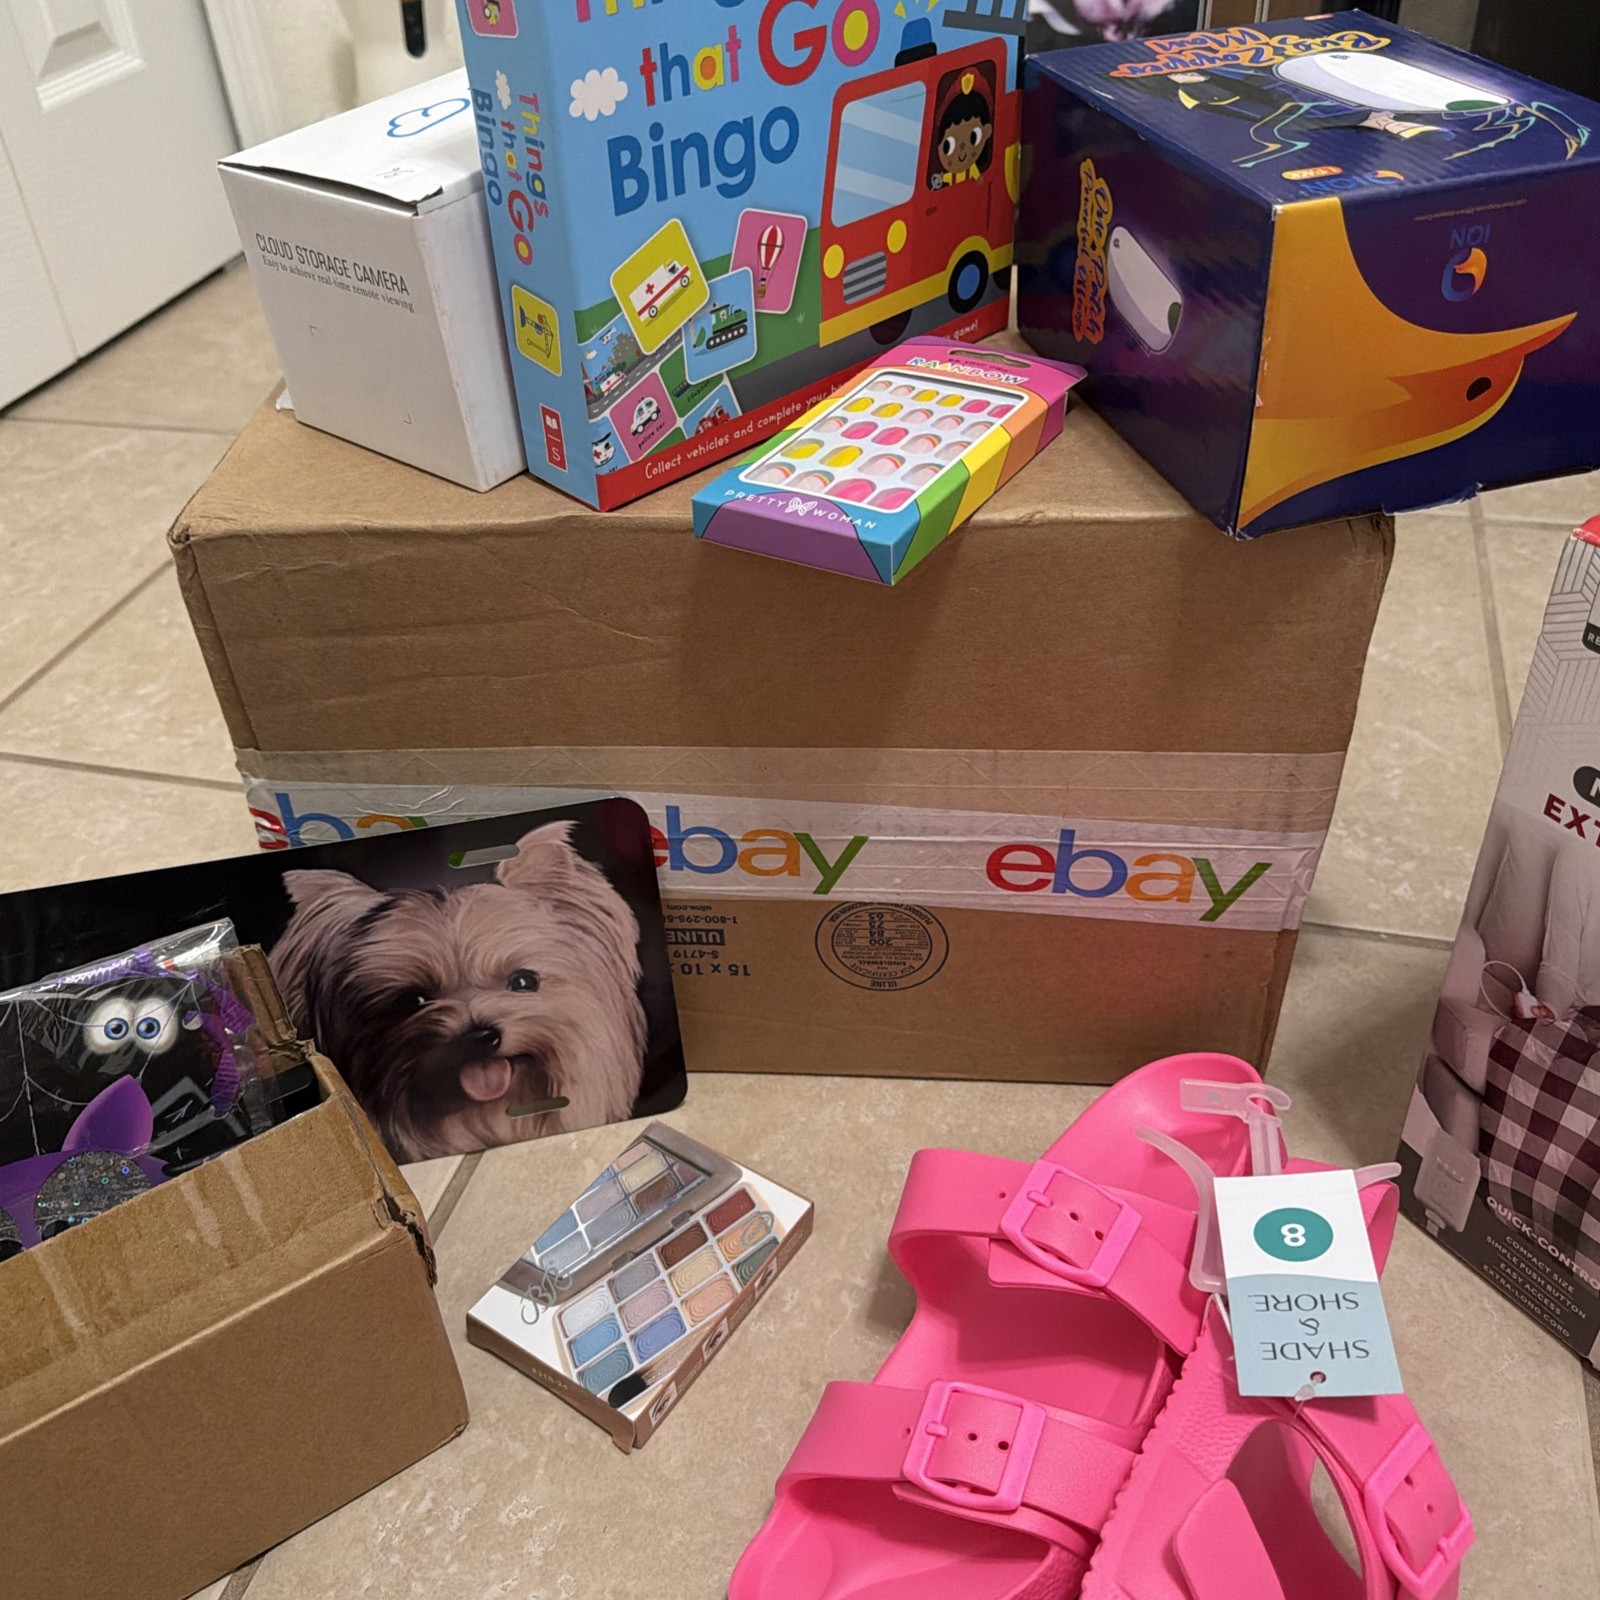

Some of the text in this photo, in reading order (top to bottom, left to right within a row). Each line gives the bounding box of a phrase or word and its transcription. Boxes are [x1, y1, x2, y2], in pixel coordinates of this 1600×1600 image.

[639, 0, 880, 106] that Go
[1276, 33, 1382, 52] Bug
[471, 88, 503, 206] Bingo
[518, 93, 549, 218] Things
[606, 106, 800, 216] Bingo
[501, 119, 535, 266] that Go
[1450, 222, 1492, 249] ION
[256, 233, 410, 296] CLOUD STORAGE CAMERA
[261, 255, 279, 271] Easy
[280, 262, 288, 272] to
[289, 266, 316, 281] achieve
[352, 286, 380, 301] remote
[381, 294, 415, 313] viewing
[637, 429, 655, 450] police
[645, 454, 682, 479] Collect
[686, 434, 730, 459] vehicles
[733, 426, 754, 440] and
[757, 404, 801, 429] complete
[806, 393, 828, 411] your
[724, 489, 877, 529] PRETTY WOMAN
[649, 805, 869, 895] bay
[984, 828, 1272, 922] ebay
[667, 930, 721, 944] ULINE
[673, 949, 719, 959] S-4719
[680, 962, 704, 976] 10
[711, 963, 722, 974] x
[728, 963, 751, 977] 15
[1280, 1223, 1306, 1247] 8
[1486, 1235, 1586, 1319] SIMPLE PUSH BUTTON
[1500, 1262, 1561, 1315] EASY ACCESS
[1506, 1236, 1575, 1294] COMPACT SIZE
[1298, 1317, 1319, 1336] &
[1483, 1265, 1570, 1337] EXTRA-LONG CORD
[1259, 1340, 1370, 1361] SHADE
